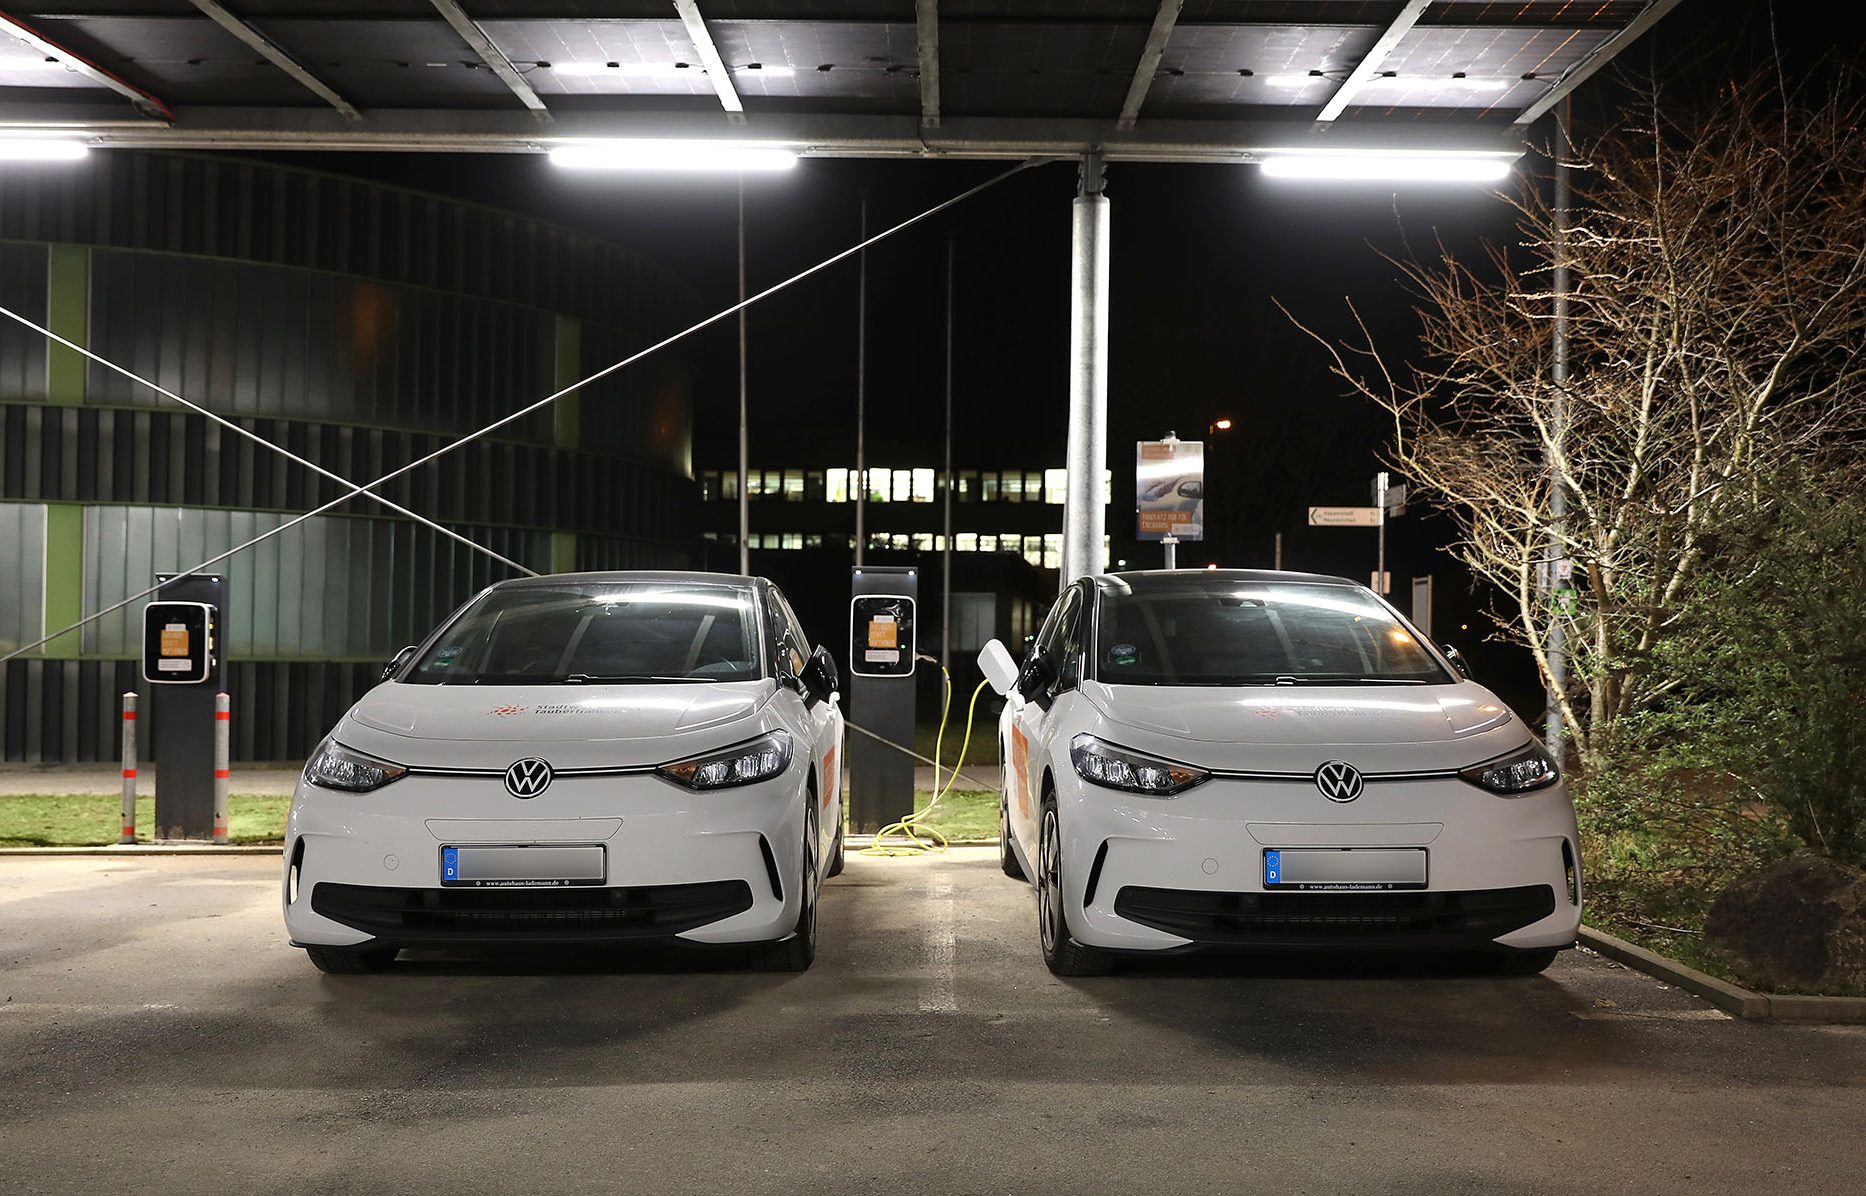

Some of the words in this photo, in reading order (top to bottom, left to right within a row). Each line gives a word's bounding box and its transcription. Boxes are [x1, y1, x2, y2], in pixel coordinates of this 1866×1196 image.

[508, 759, 550, 795] VW
[1318, 763, 1360, 799] VW
[447, 868, 454, 876] D
[1269, 871, 1277, 879] D
